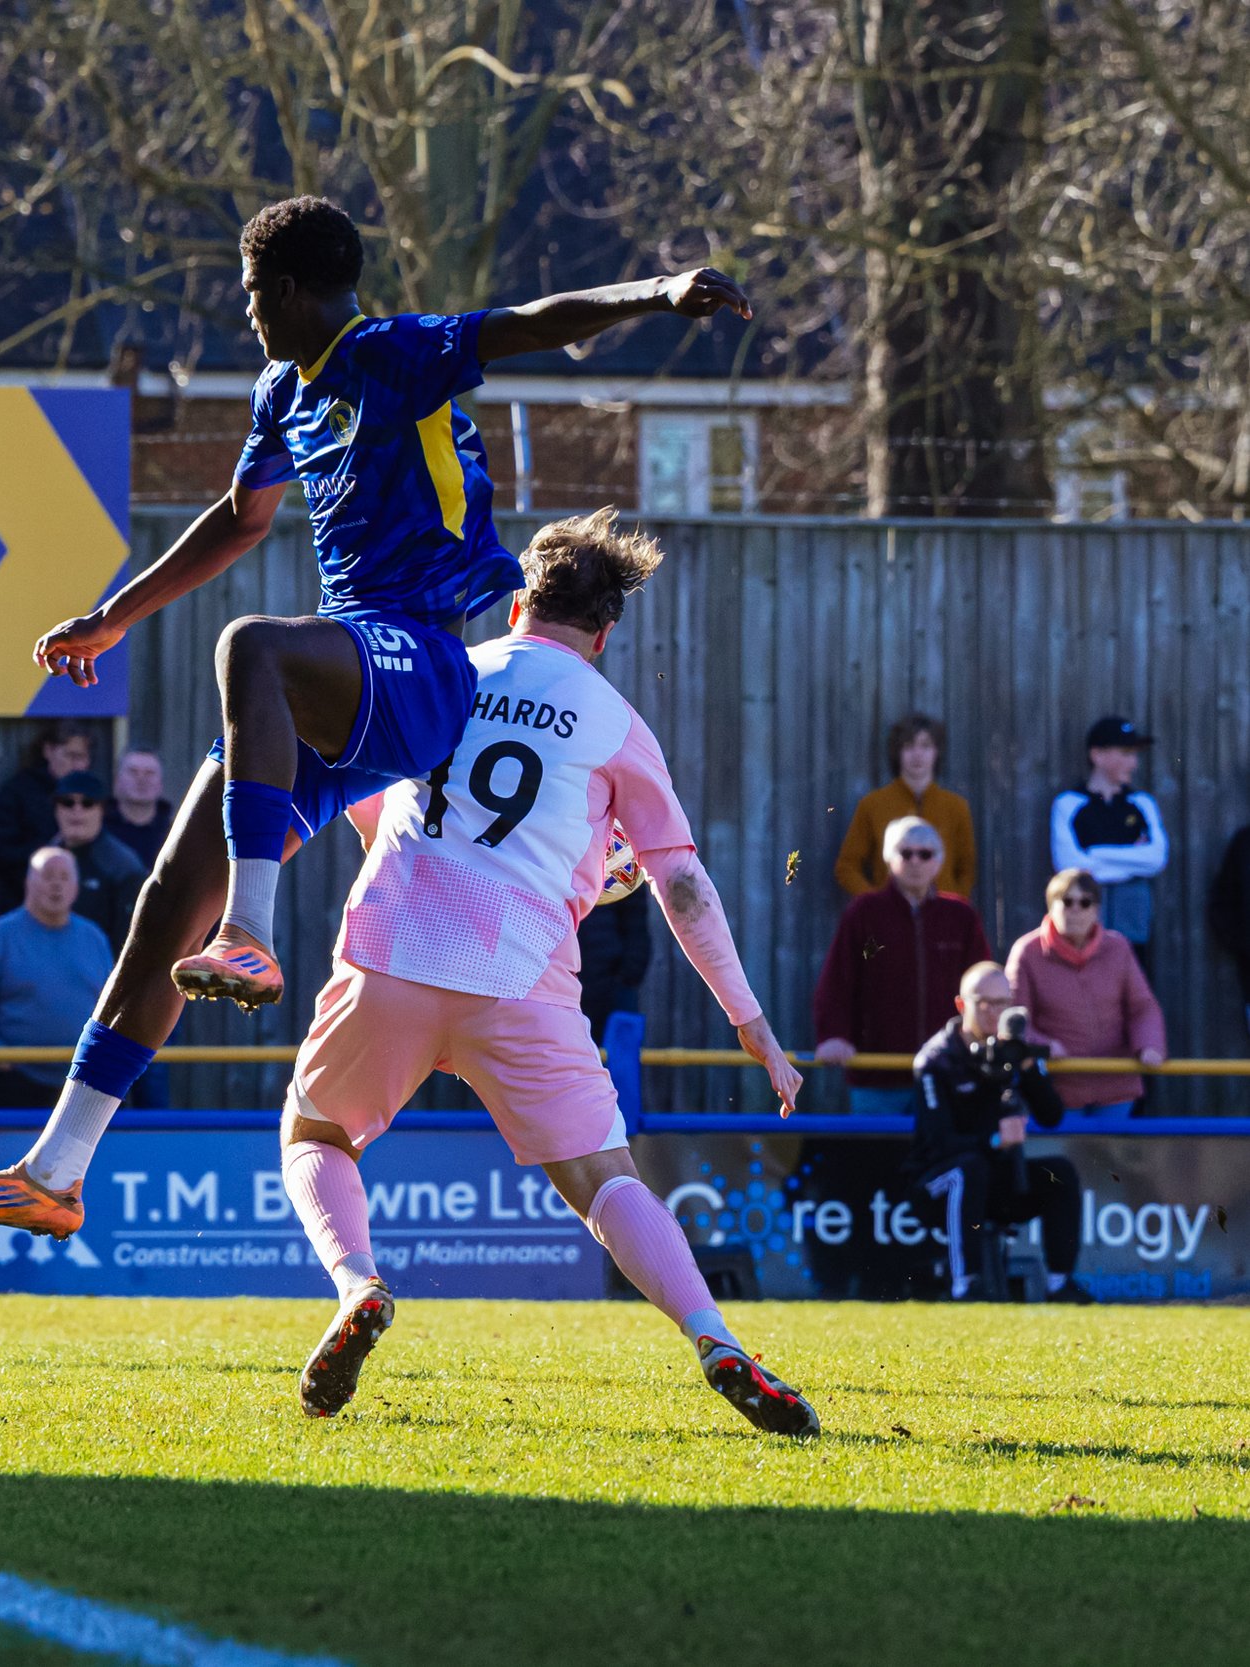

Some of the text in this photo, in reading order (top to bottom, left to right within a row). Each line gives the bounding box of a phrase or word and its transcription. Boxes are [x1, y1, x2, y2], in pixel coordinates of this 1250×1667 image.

[470, 691, 578, 739] HARDS
[423, 740, 544, 849] 19
[111, 1171, 237, 1221] T.M.
[253, 1171, 478, 1221] Bwne
[869, 1189, 1210, 1261] telogy
[112, 1241, 277, 1267] Construction
[283, 1241, 302, 1267] &
[413, 1241, 580, 1265] Maintenance
